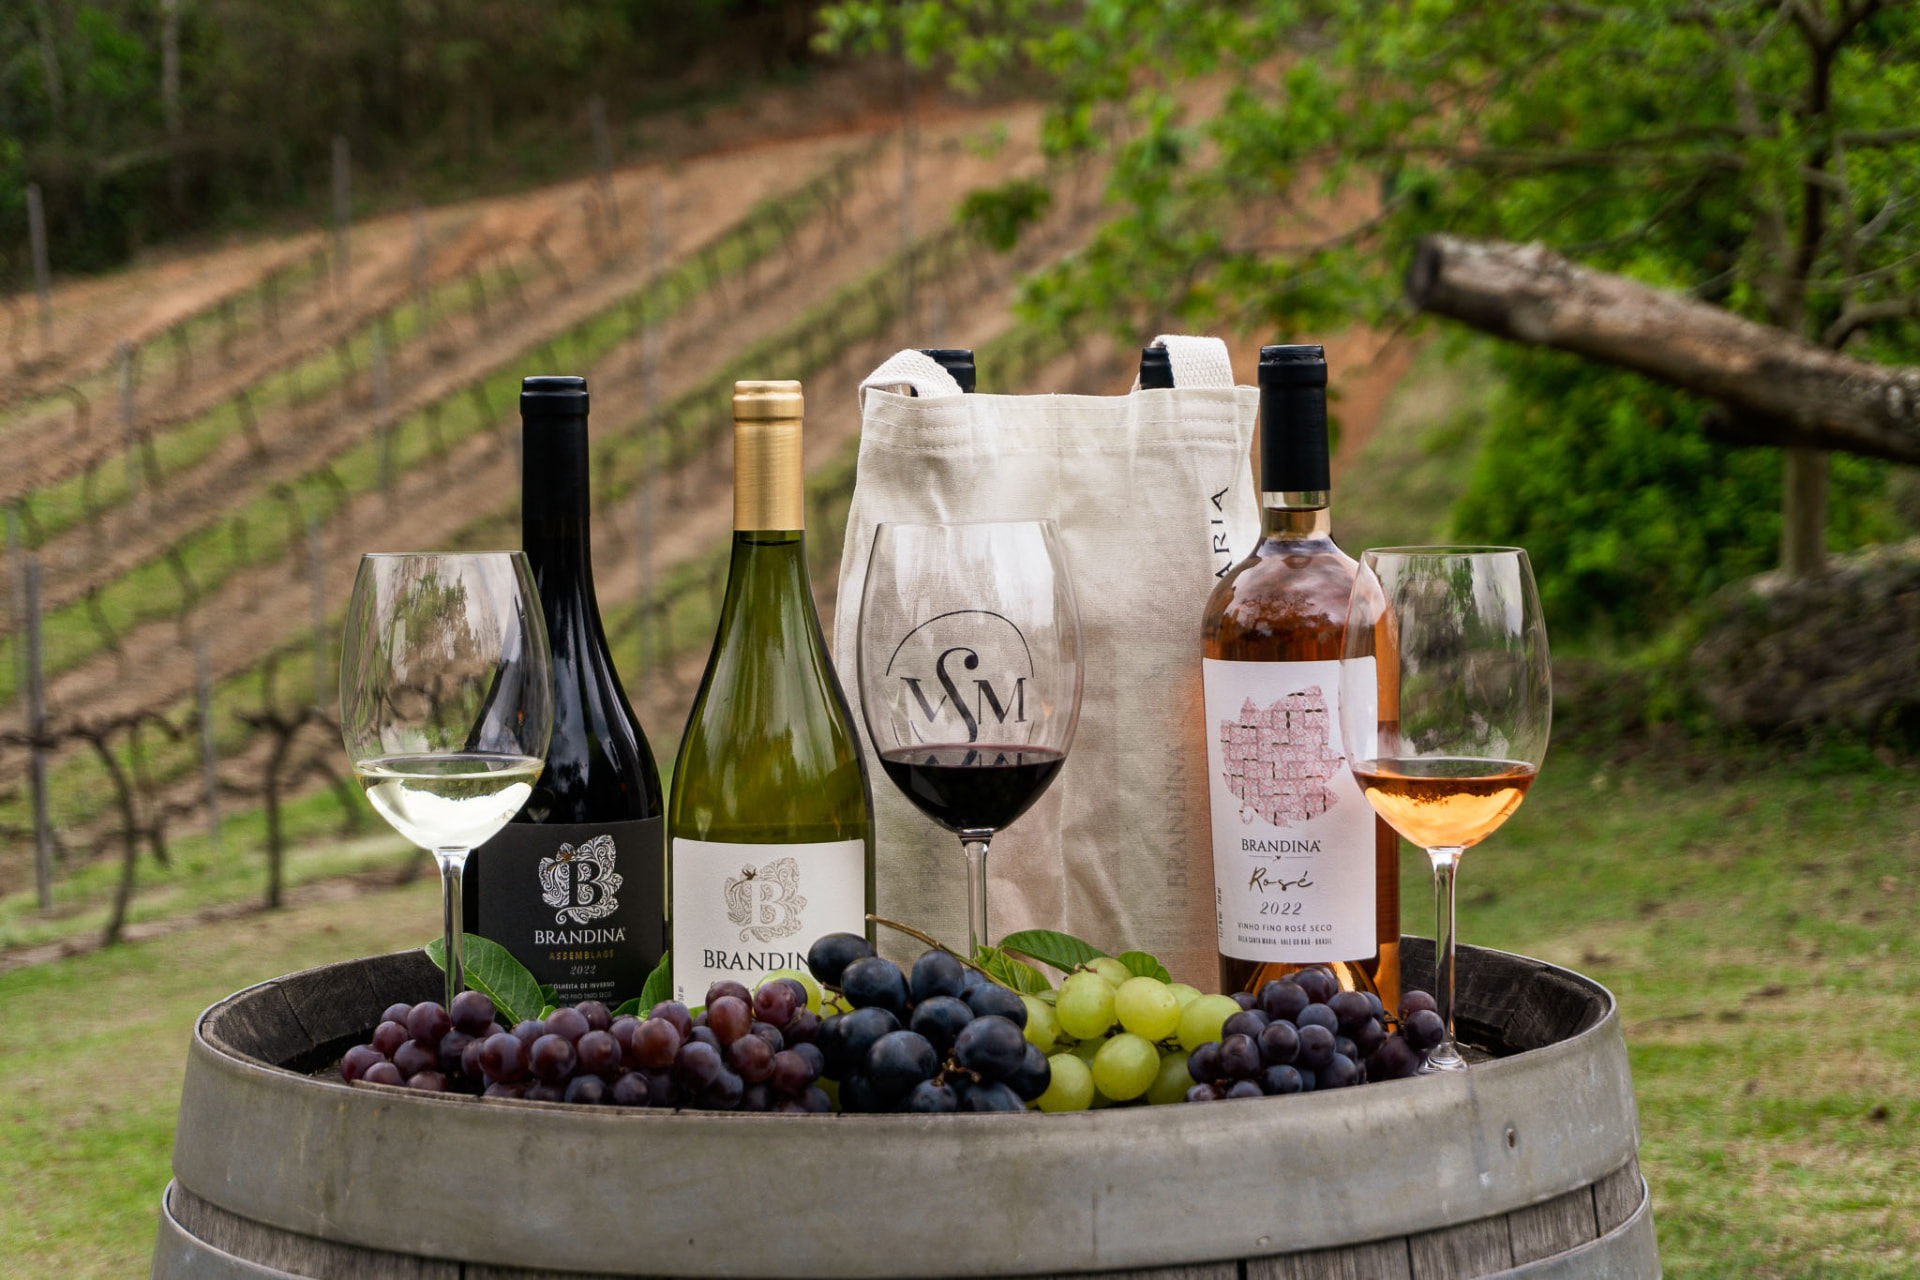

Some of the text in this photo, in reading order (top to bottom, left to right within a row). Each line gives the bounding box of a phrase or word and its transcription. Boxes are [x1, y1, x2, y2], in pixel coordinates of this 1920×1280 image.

[1210, 486, 1233, 579] ARIA
[1166, 743, 1188, 888] BRANDINA
[1241, 838, 1321, 853] BRANDINA
[1248, 866, 1314, 894] Rosé
[1259, 901, 1303, 916] 2022
[1237, 921, 1333, 933] VINHO FINO ROSÉ SECO
[534, 928, 626, 945] BRANDINA
[548, 949, 614, 961] ASSEMBLAGE
[703, 948, 809, 971] BRANDIN
[569, 964, 597, 976] 2022
